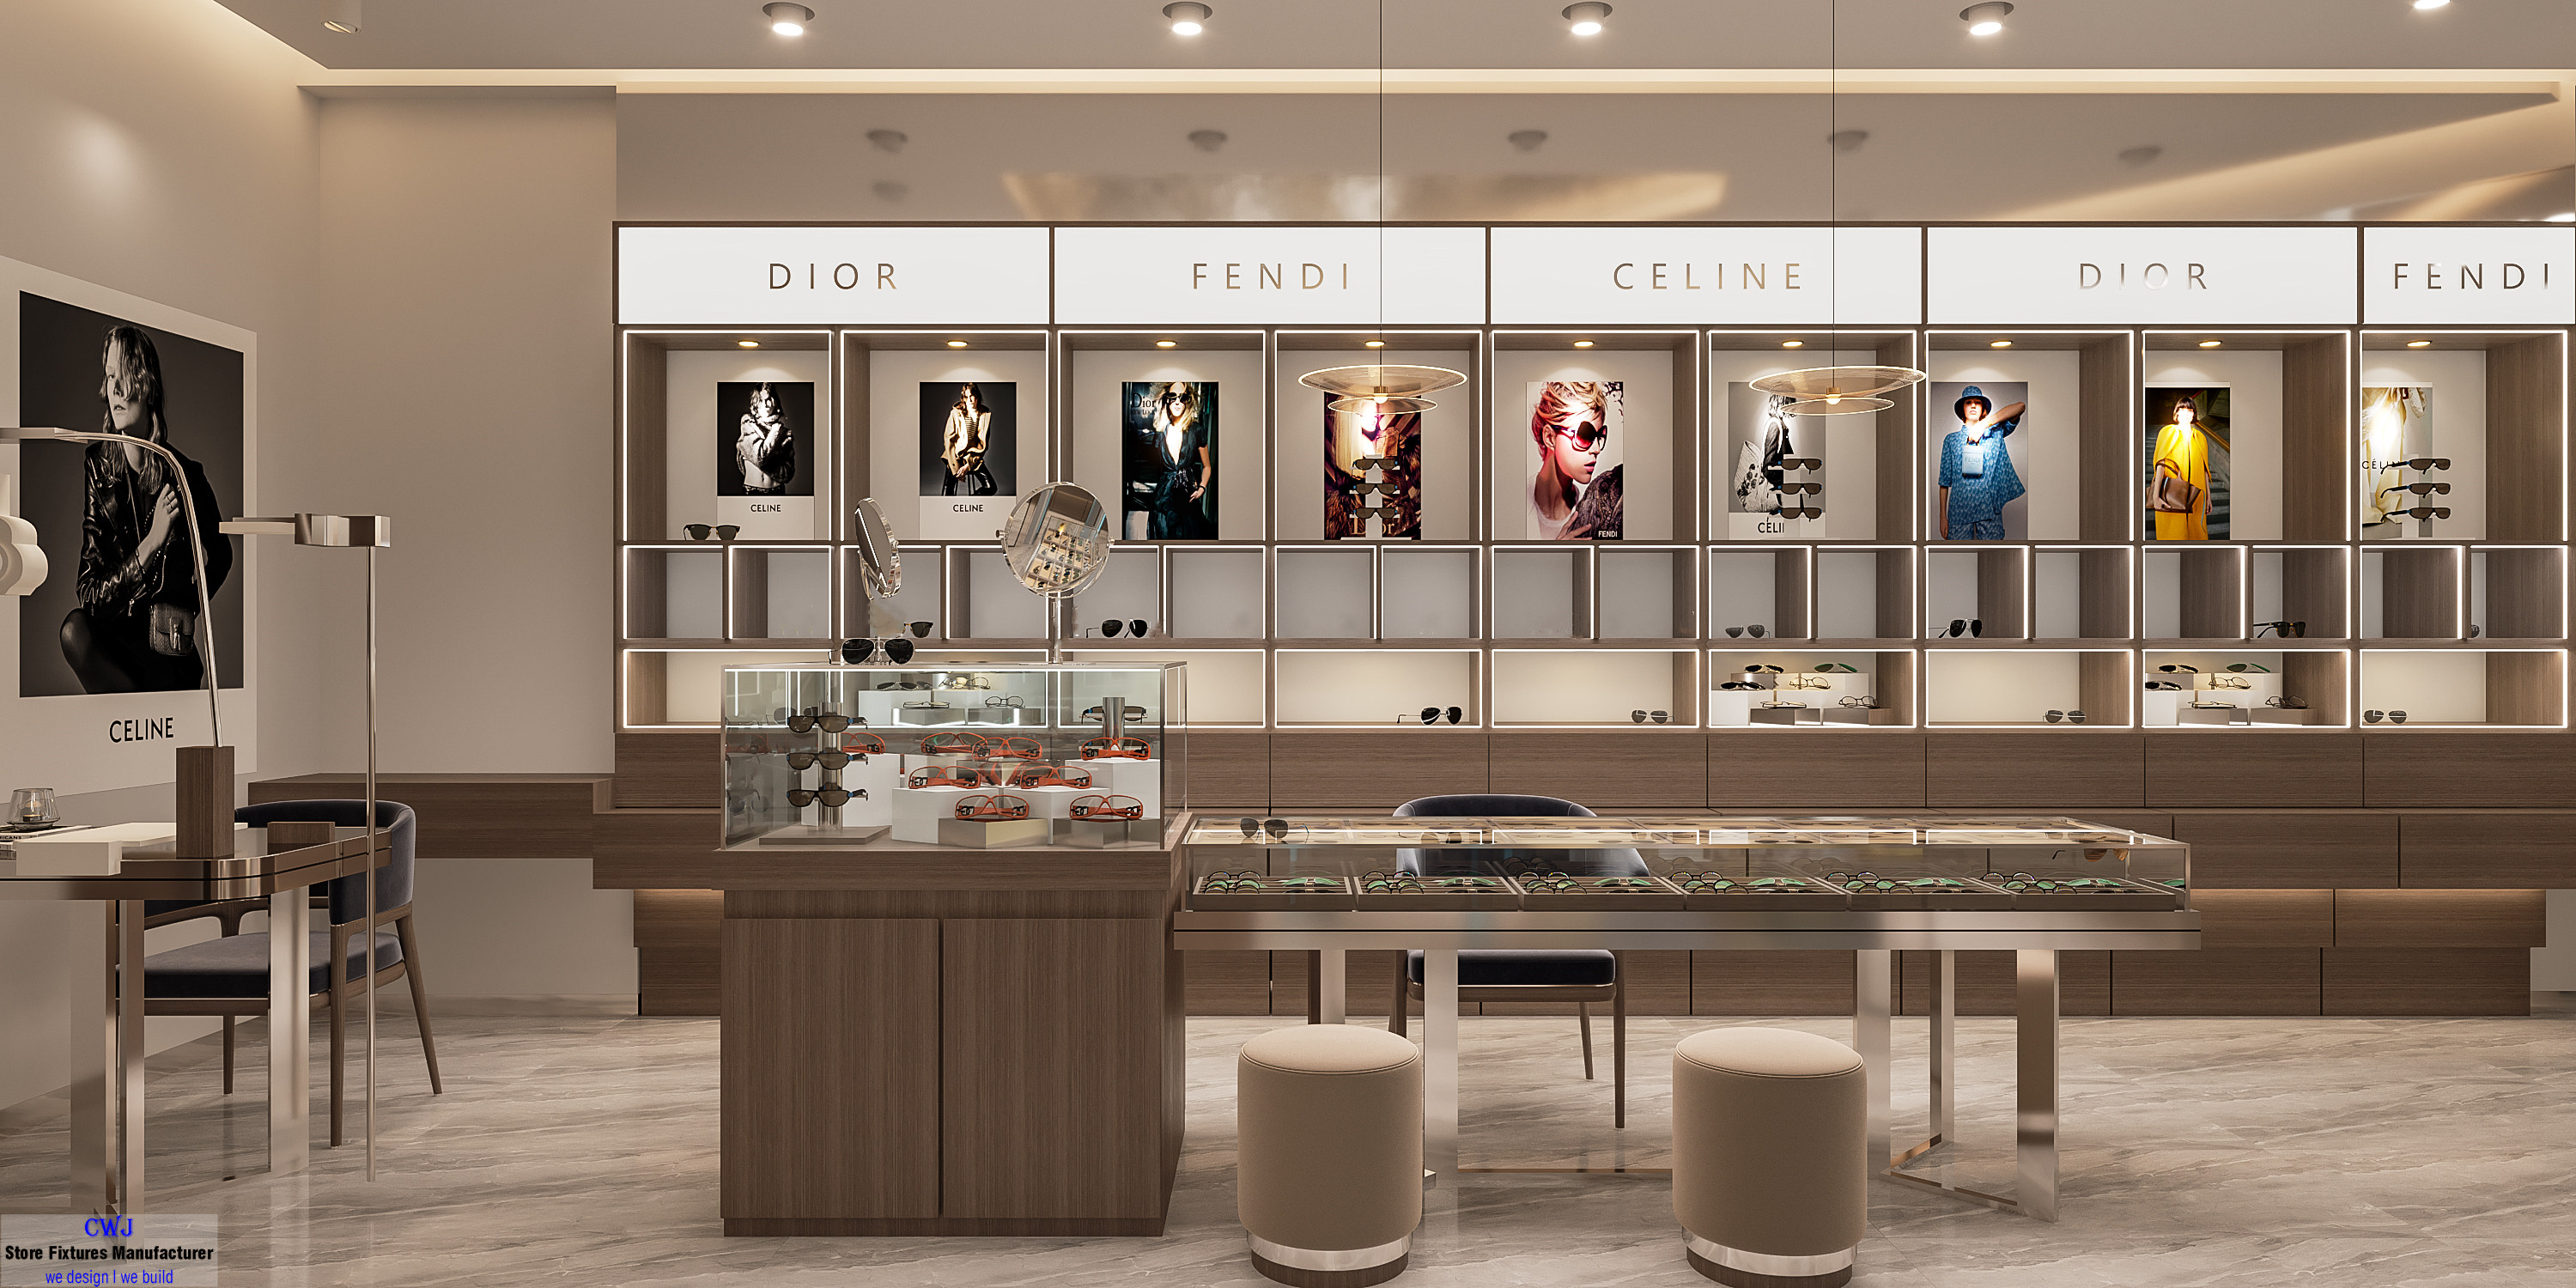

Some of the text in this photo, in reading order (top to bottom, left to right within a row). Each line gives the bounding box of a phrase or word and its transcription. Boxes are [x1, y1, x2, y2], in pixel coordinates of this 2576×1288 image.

[770, 262, 897, 290] DIOR
[1193, 262, 1347, 290] FENDI
[1613, 262, 1801, 290] CELINE
[2079, 262, 2208, 290] DIOR
[2394, 262, 2549, 290] FENDI
[1131, 392, 1157, 408] Dior
[750, 504, 781, 513] CELINE
[952, 504, 984, 513] CELINE
[109, 716, 175, 744] CELINE
